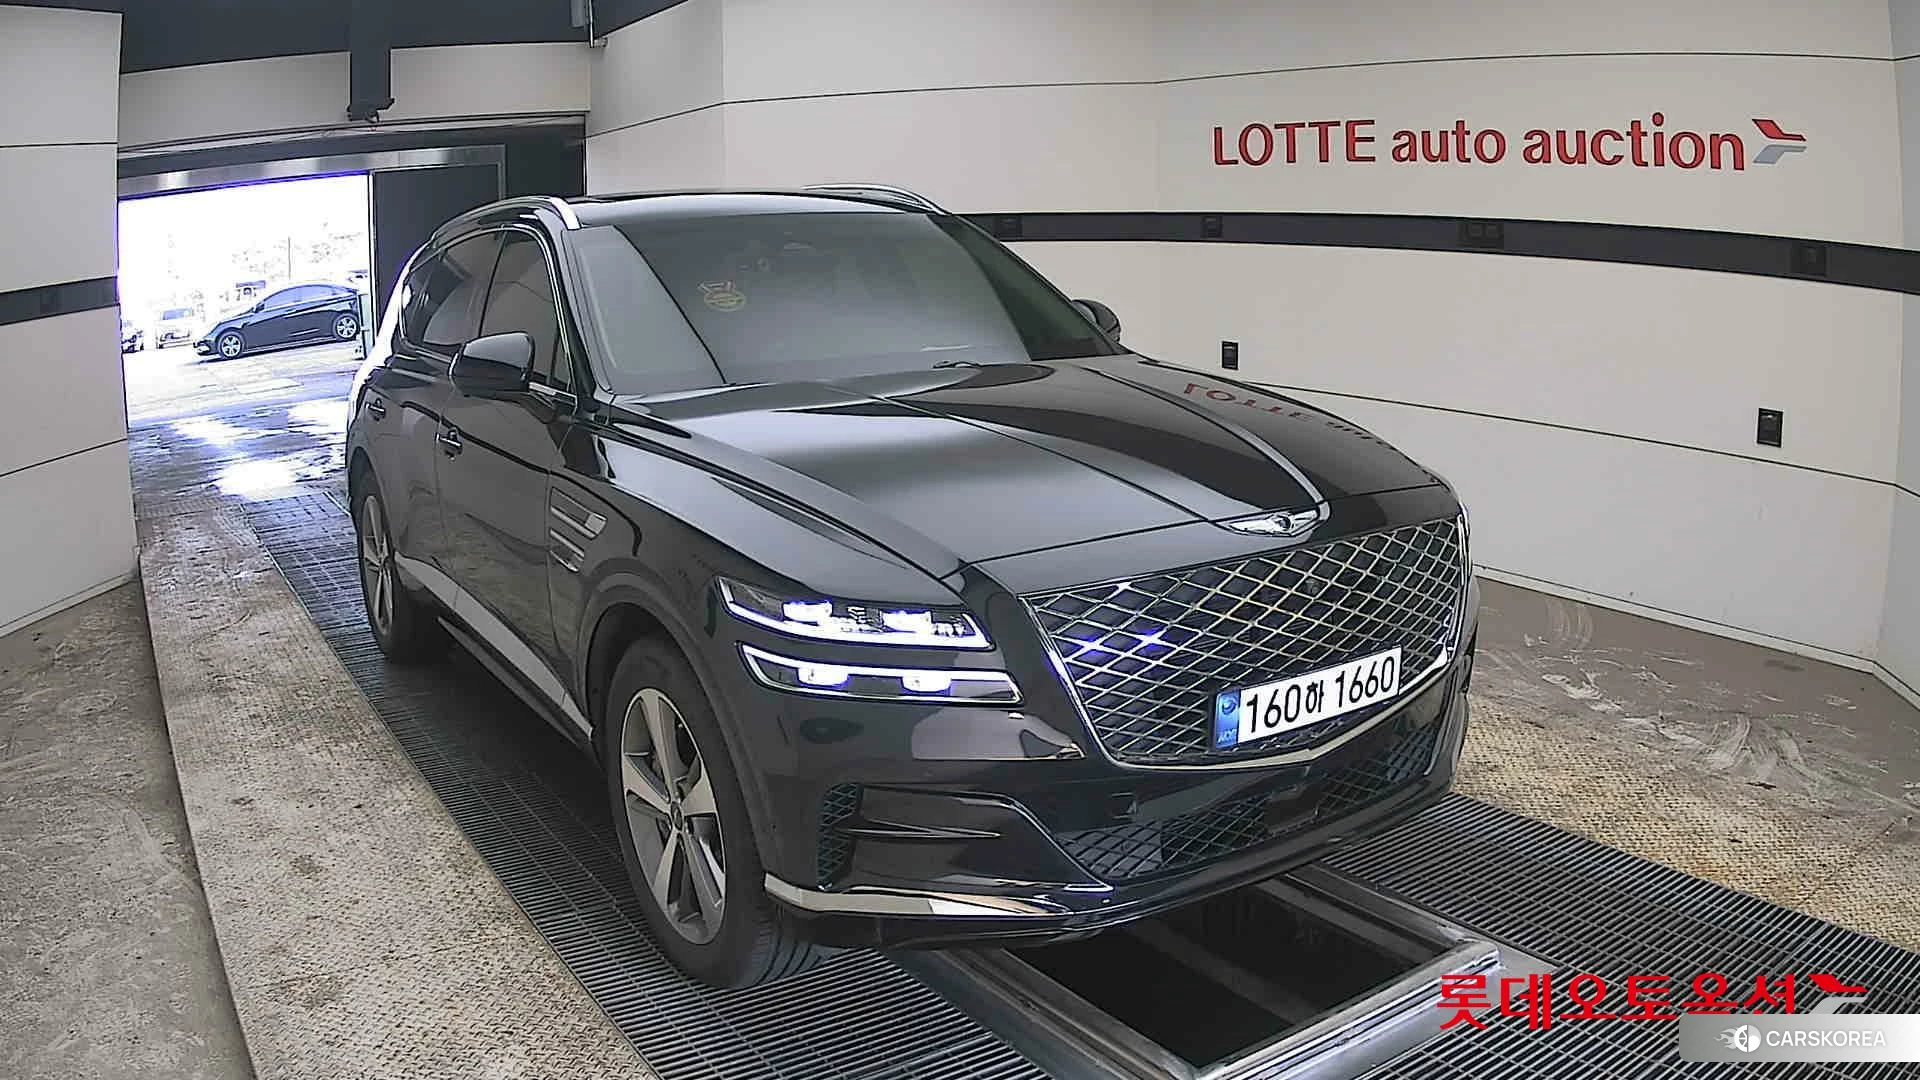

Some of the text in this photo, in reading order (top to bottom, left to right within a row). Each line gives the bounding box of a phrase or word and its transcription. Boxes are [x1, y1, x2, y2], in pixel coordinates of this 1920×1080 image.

[1213, 111, 1745, 171] LOTTE auto auction
[1246, 655, 1396, 734] 160하 1660
